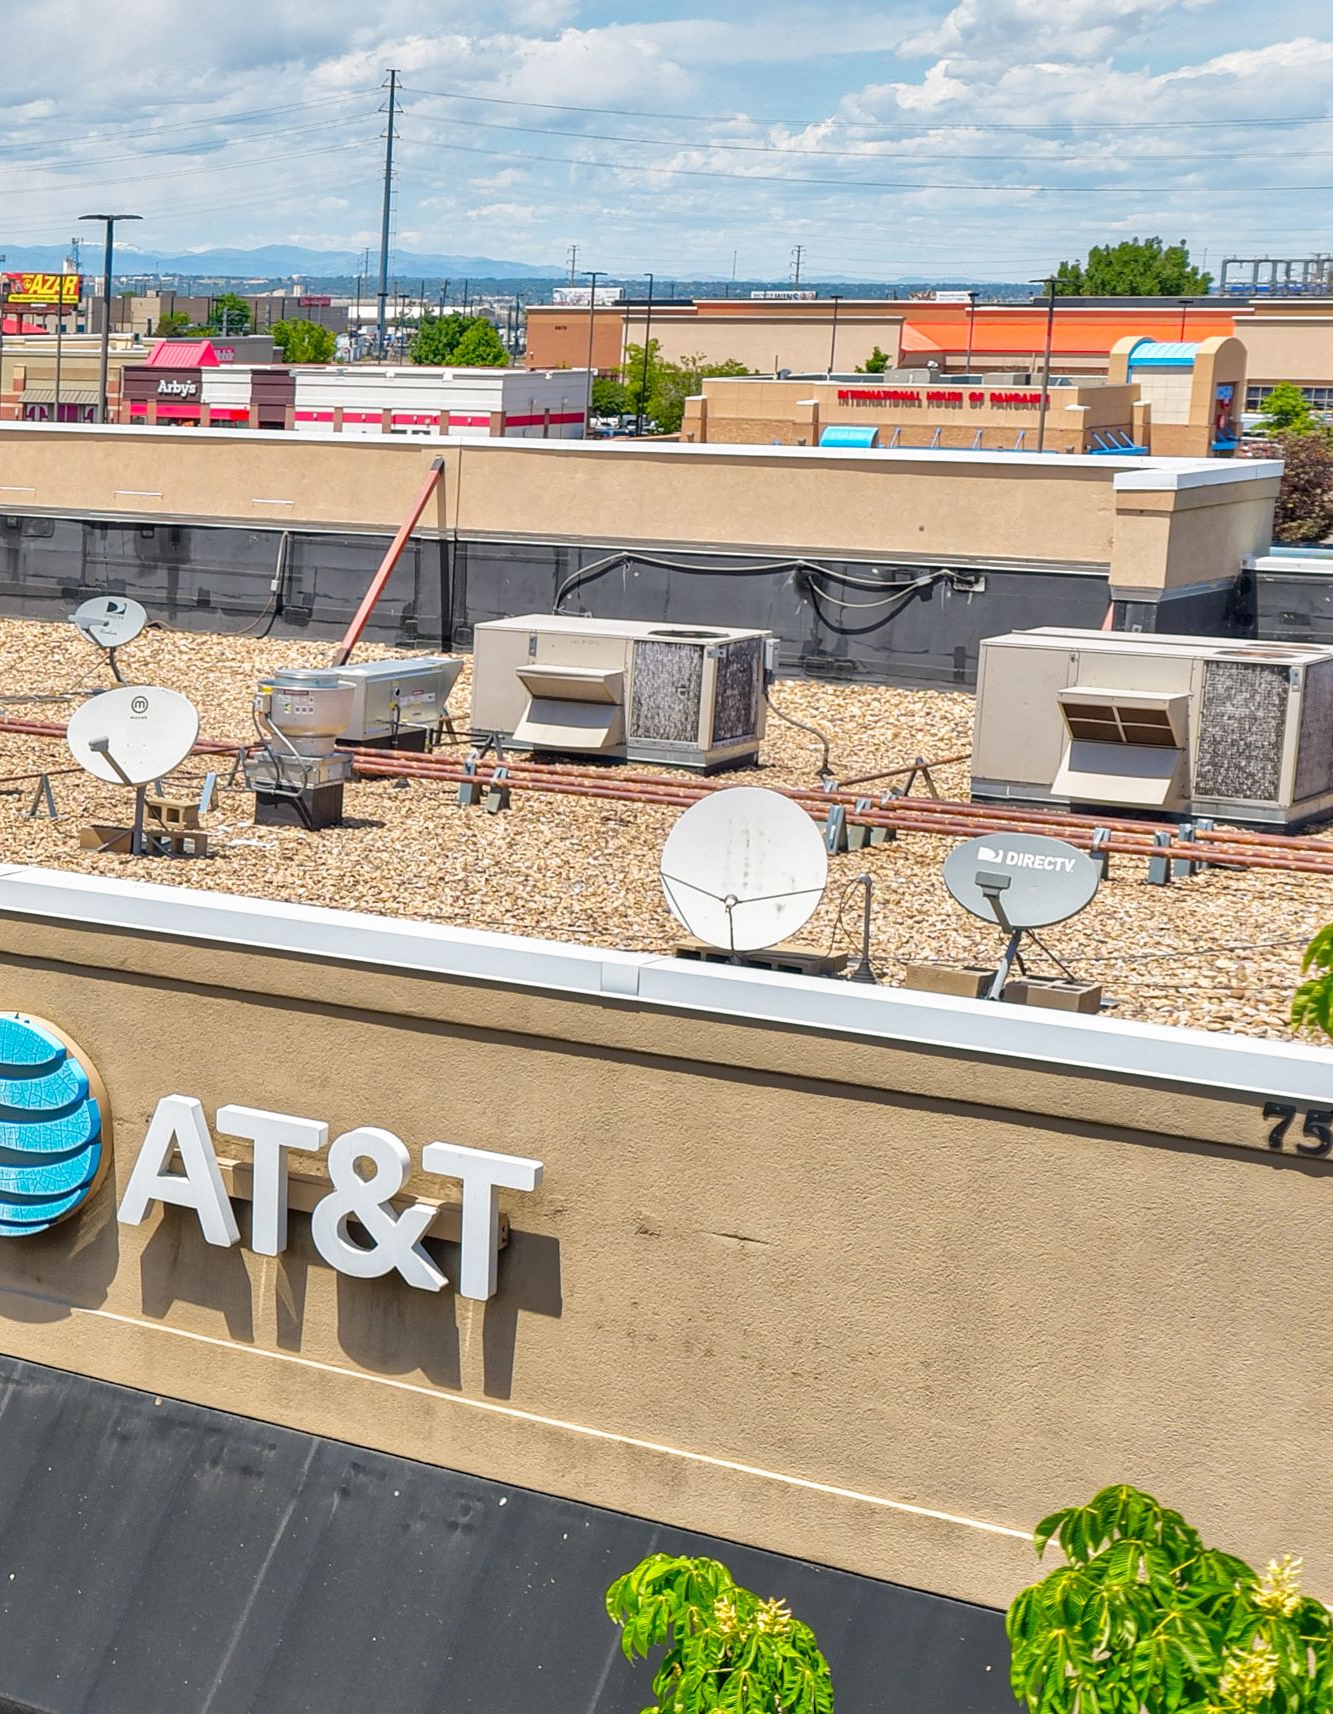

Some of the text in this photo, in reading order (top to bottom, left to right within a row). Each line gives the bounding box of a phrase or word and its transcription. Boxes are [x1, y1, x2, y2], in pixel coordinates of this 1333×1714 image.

[157, 379, 197, 397] Arby's
[837, 389, 921, 401] INTERNATIONAL
[968, 391, 985, 403] OF
[1006, 850, 1075, 872] DIRECTV
[117, 1094, 544, 1301] AT&T
